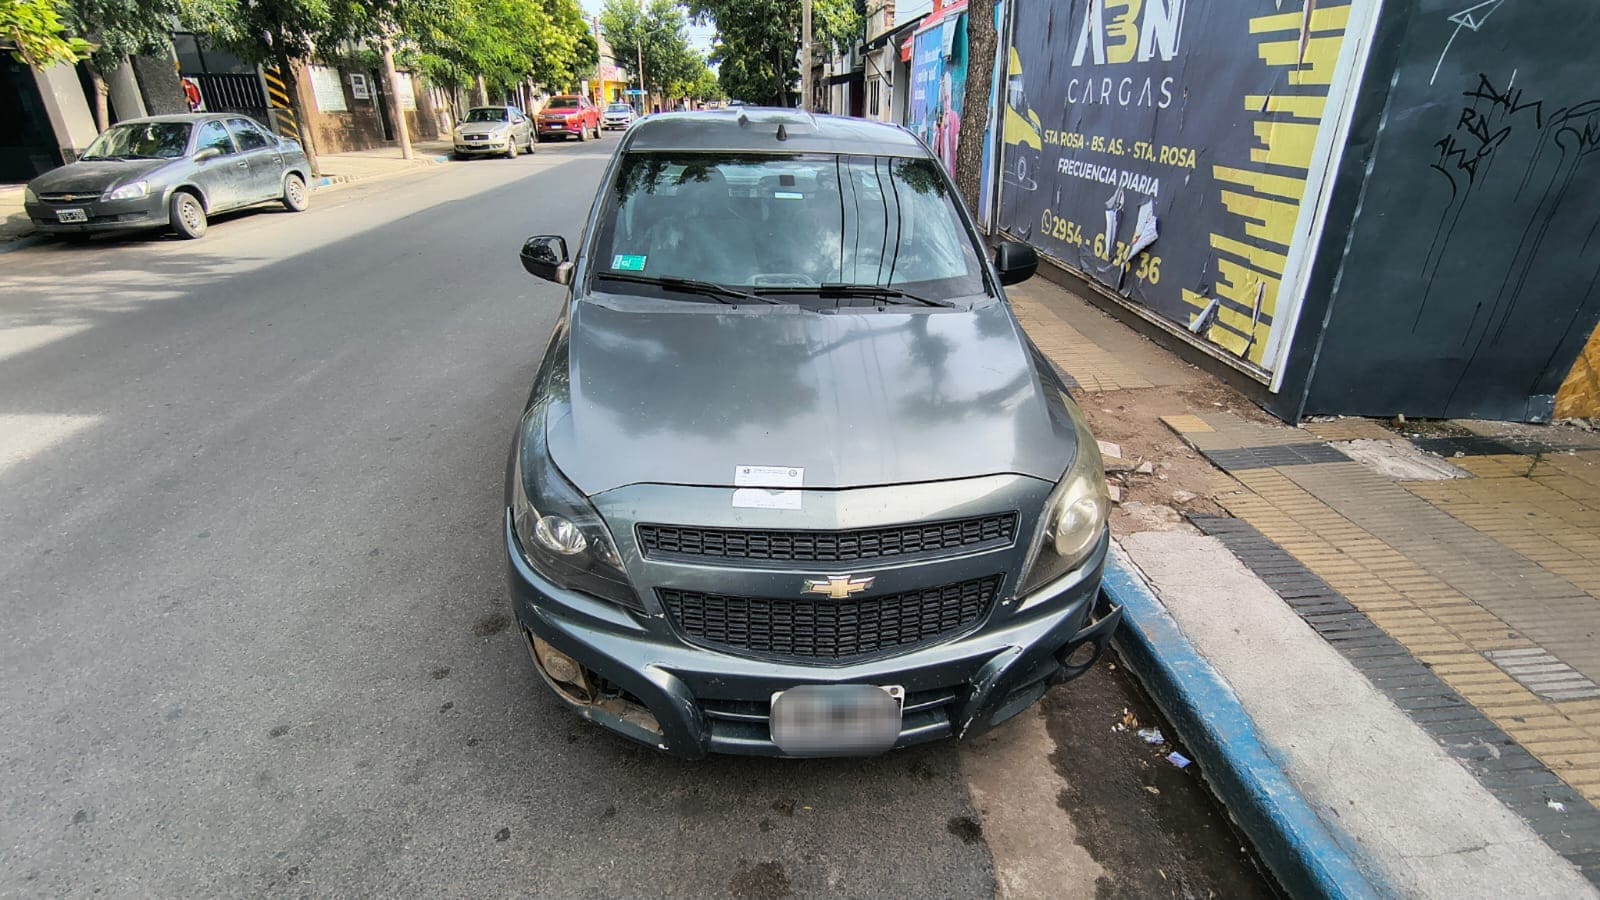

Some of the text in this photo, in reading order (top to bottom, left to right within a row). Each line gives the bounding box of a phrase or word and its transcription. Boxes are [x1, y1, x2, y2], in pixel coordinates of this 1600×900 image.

[1067, 77, 1174, 108] CARGAS
[1060, 131, 1084, 149] ROSA
[1091, 135, 1106, 153] BS.
[1107, 137, 1125, 156] AS.
[1133, 141, 1156, 162] STA.
[1160, 145, 1196, 169] ROSA
[1057, 157, 1159, 197] FRECUENCIA DIARIA
[1052, 215, 1083, 248] 2954
